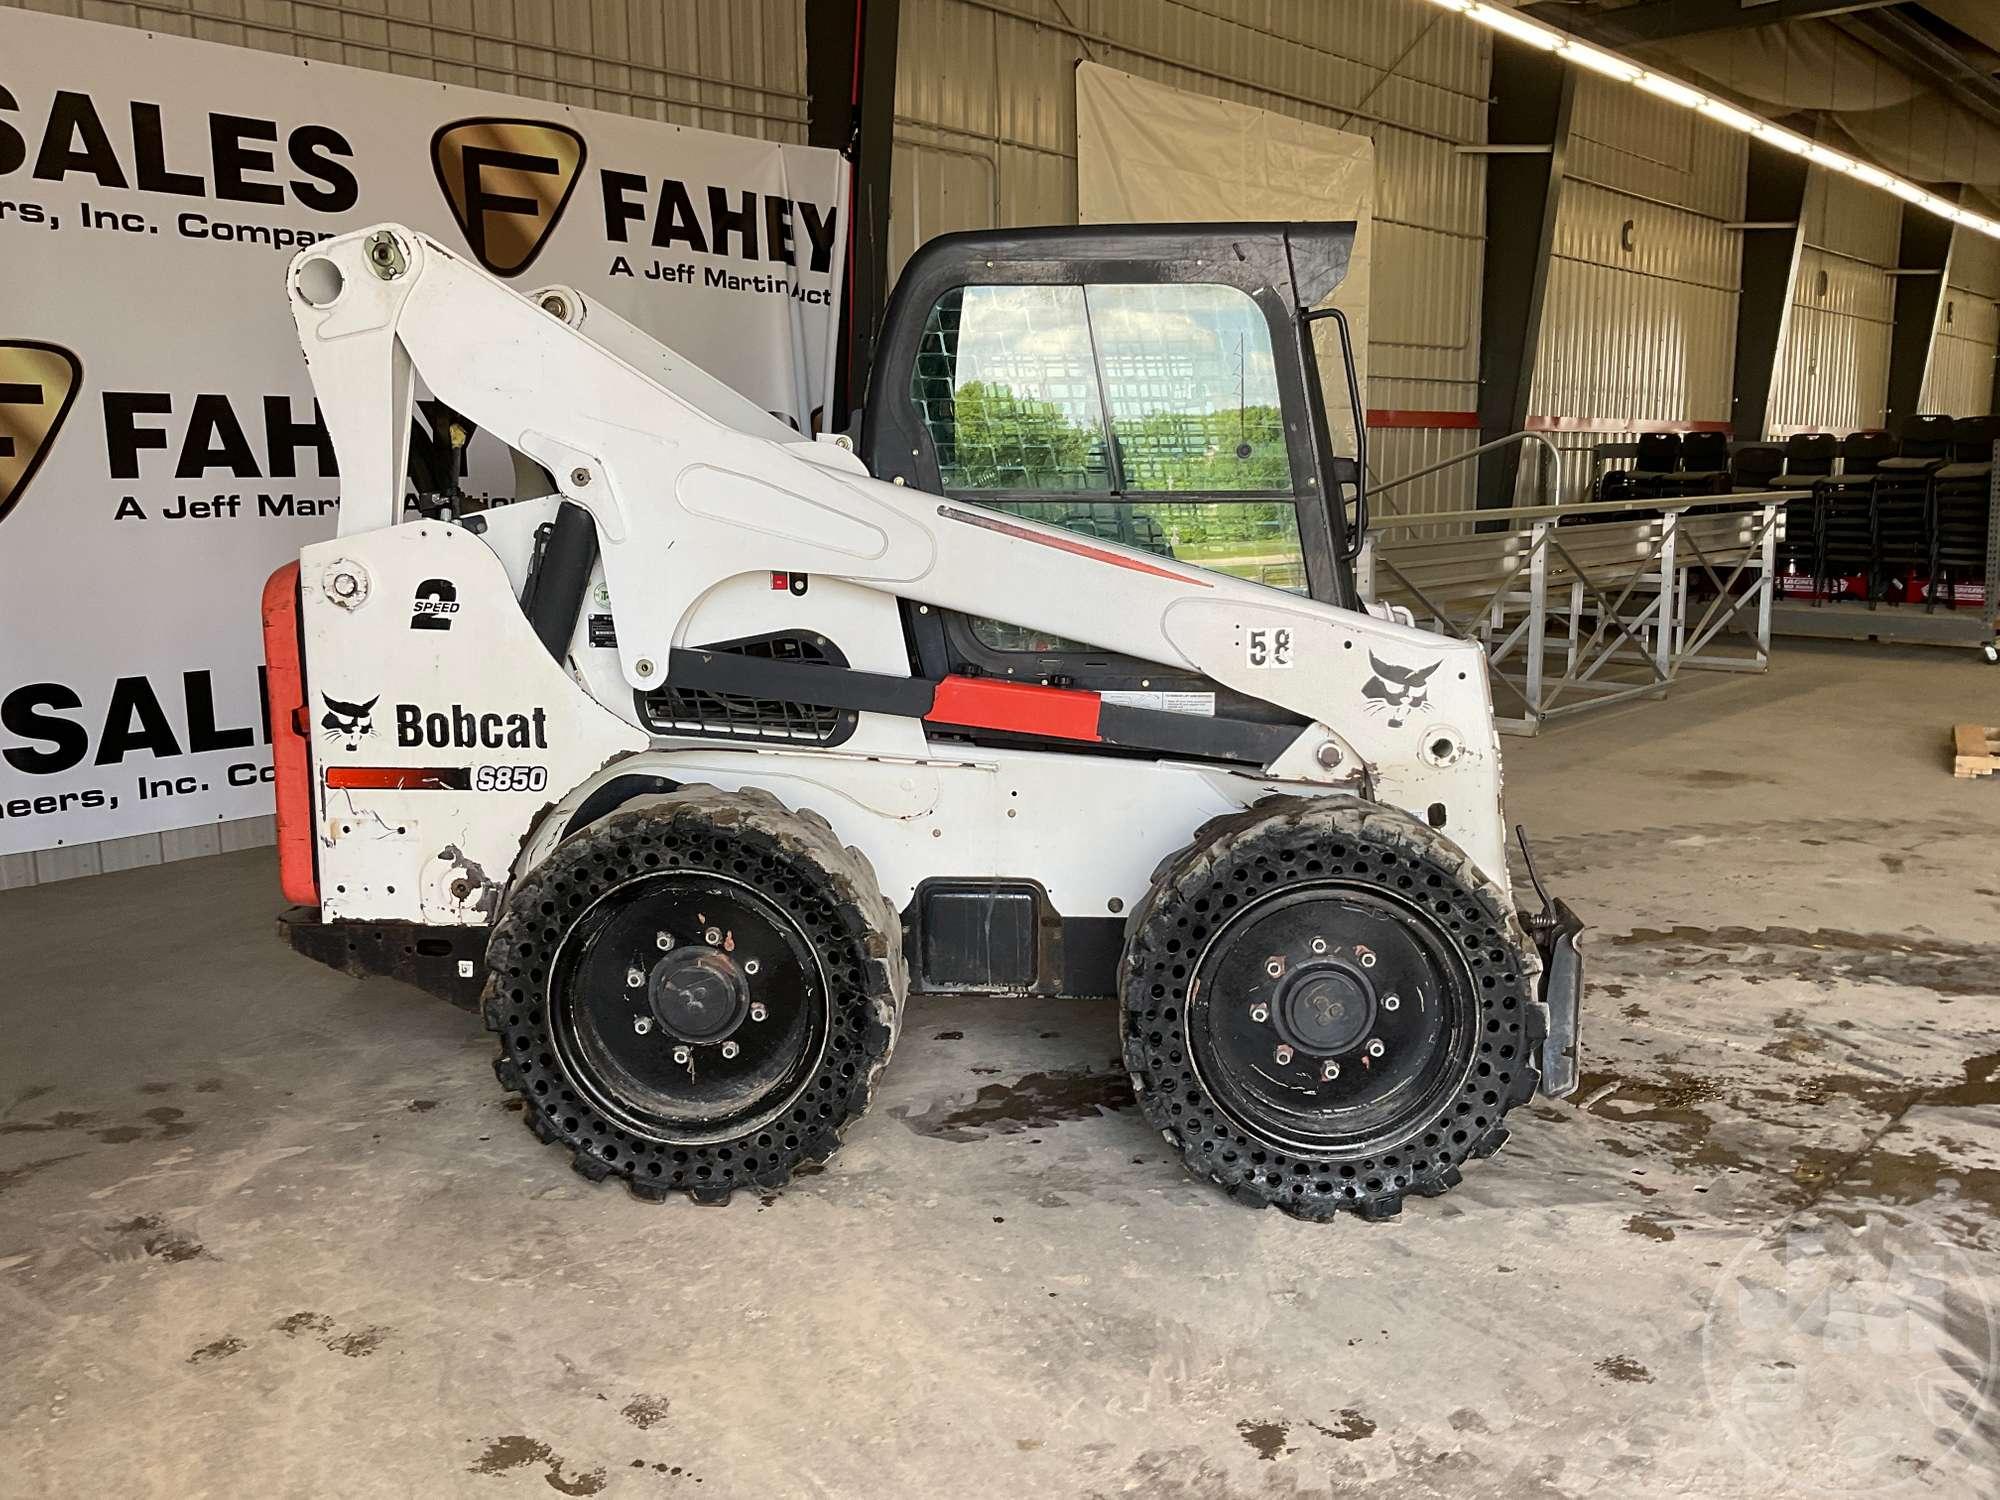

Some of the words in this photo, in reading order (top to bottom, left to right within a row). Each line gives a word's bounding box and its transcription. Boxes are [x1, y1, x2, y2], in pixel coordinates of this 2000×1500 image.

[81, 202, 158, 234] Inc.
[609, 256, 634, 277] A
[644, 259, 695, 285] Jeff
[704, 266, 789, 293] Martin
[114, 496, 147, 520] A
[163, 495, 241, 519] Jeff
[413, 601, 460, 613] SPEED
[1250, 629, 1290, 666] 58
[396, 704, 548, 749] Bobcat
[138, 776, 208, 800] Inc.
[476, 765, 548, 791] S850
